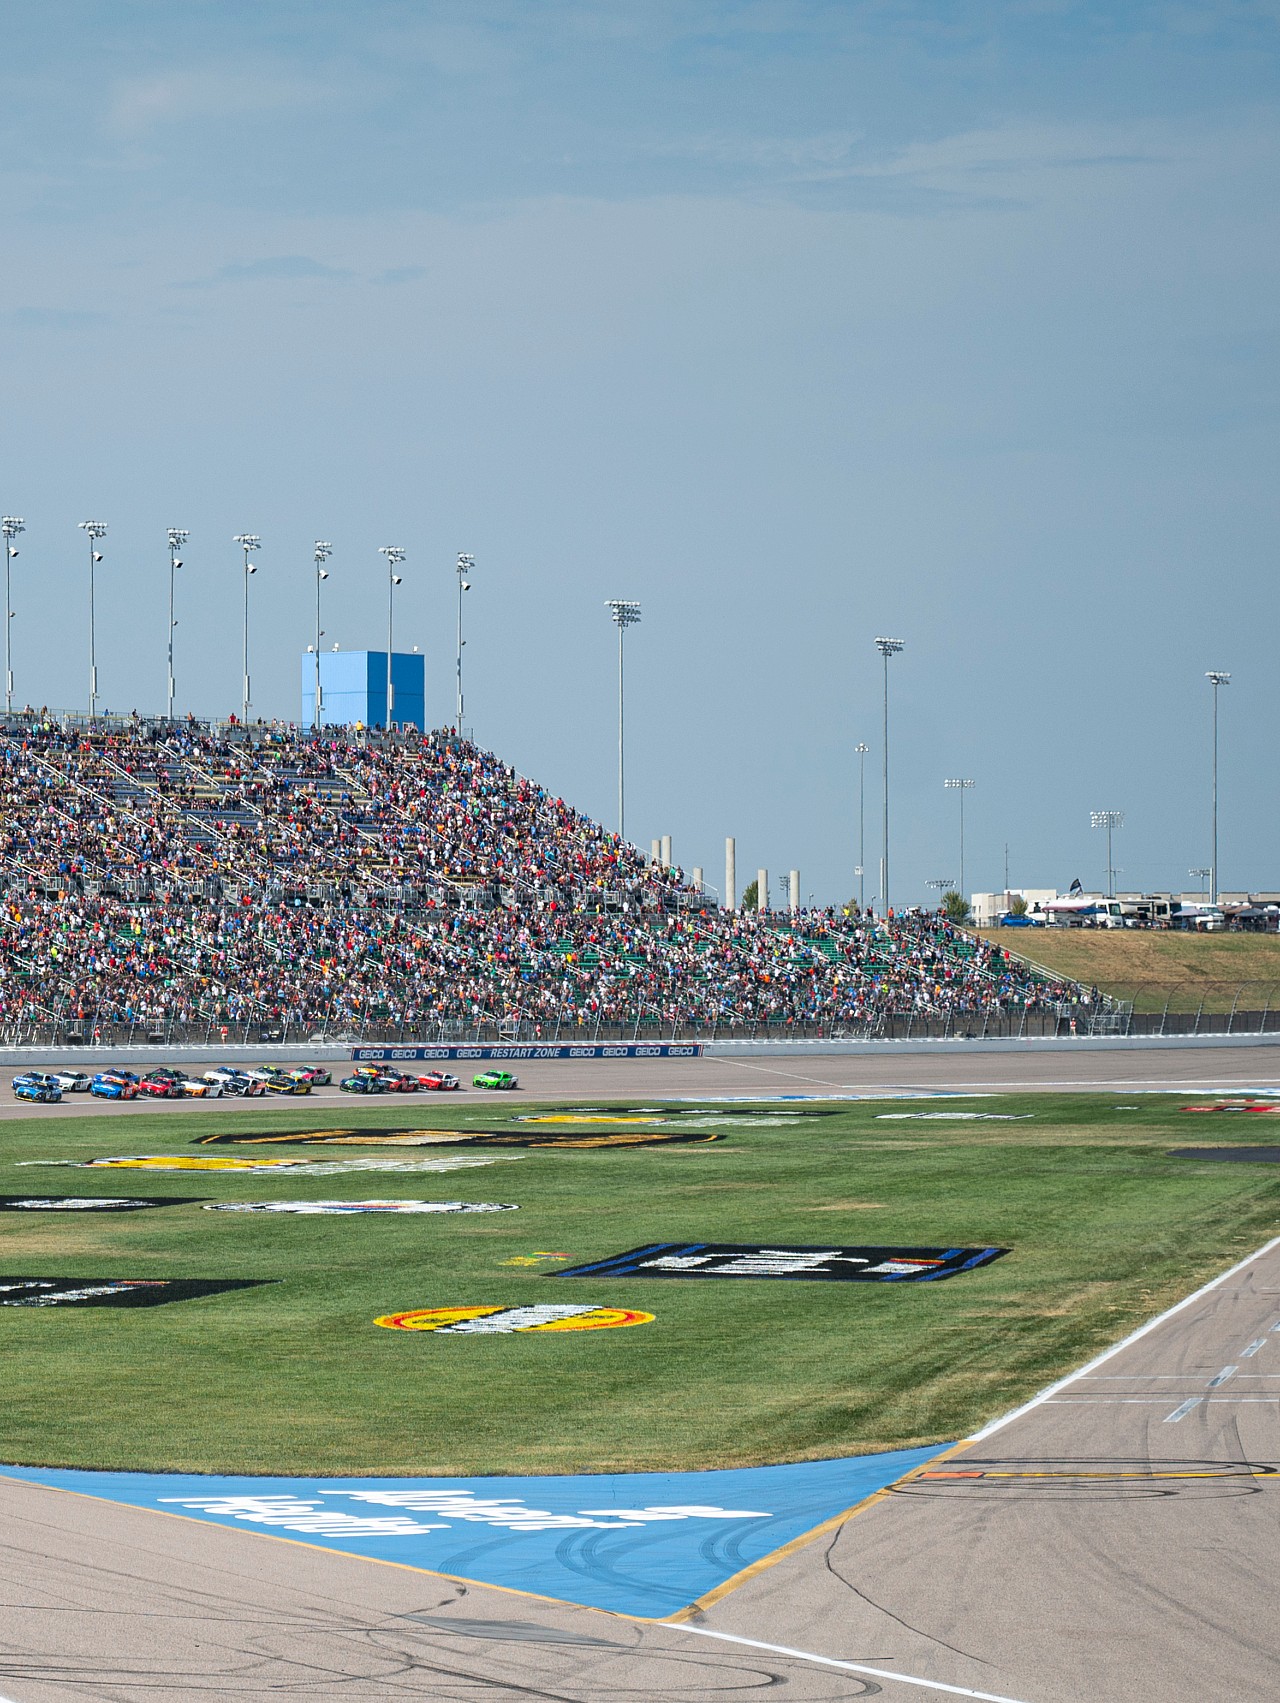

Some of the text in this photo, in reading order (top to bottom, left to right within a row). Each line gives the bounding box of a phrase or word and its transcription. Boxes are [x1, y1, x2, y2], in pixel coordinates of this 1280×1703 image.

[359, 1047, 693, 1059] GEICO GEICO GEICO GEICO RESTART ZONE GEICO GEICO GEICO GEICO
